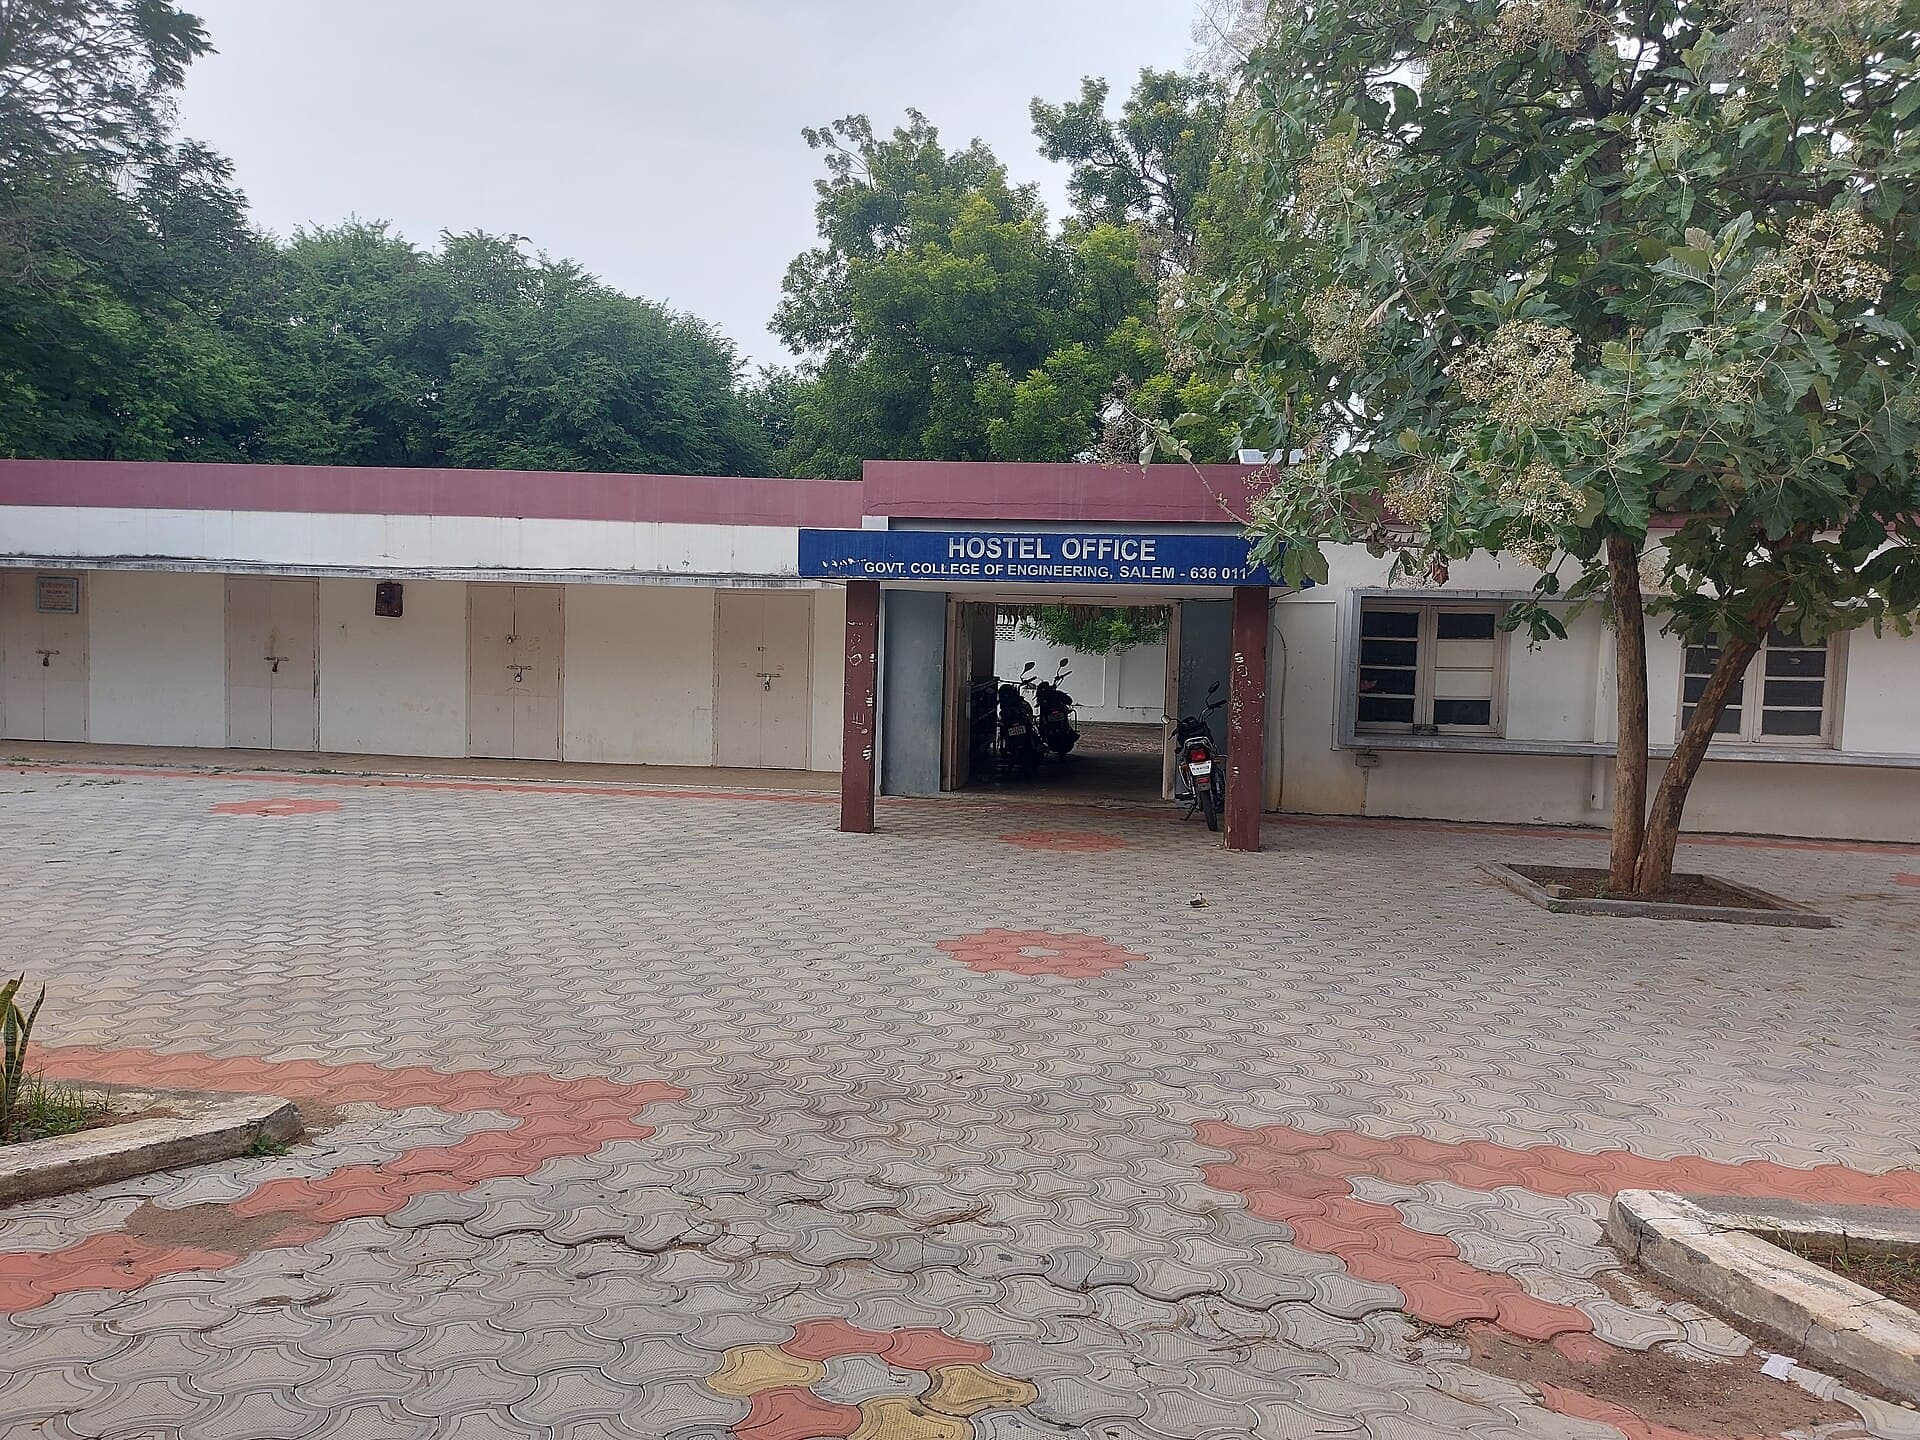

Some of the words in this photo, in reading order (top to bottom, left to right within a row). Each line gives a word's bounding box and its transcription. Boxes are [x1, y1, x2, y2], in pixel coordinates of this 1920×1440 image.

[948, 537, 1051, 559] HOSTEL
[1062, 538, 1156, 561] OFFICE
[864, 562, 907, 575] GOVT.
[910, 562, 980, 576] COLLEGE
[984, 563, 1005, 576] OF
[1007, 564, 1113, 580] ENGINEERING,
[1119, 565, 1175, 579] SALEM
[1190, 567, 1217, 580] 636
[1221, 567, 1247, 581] 011
